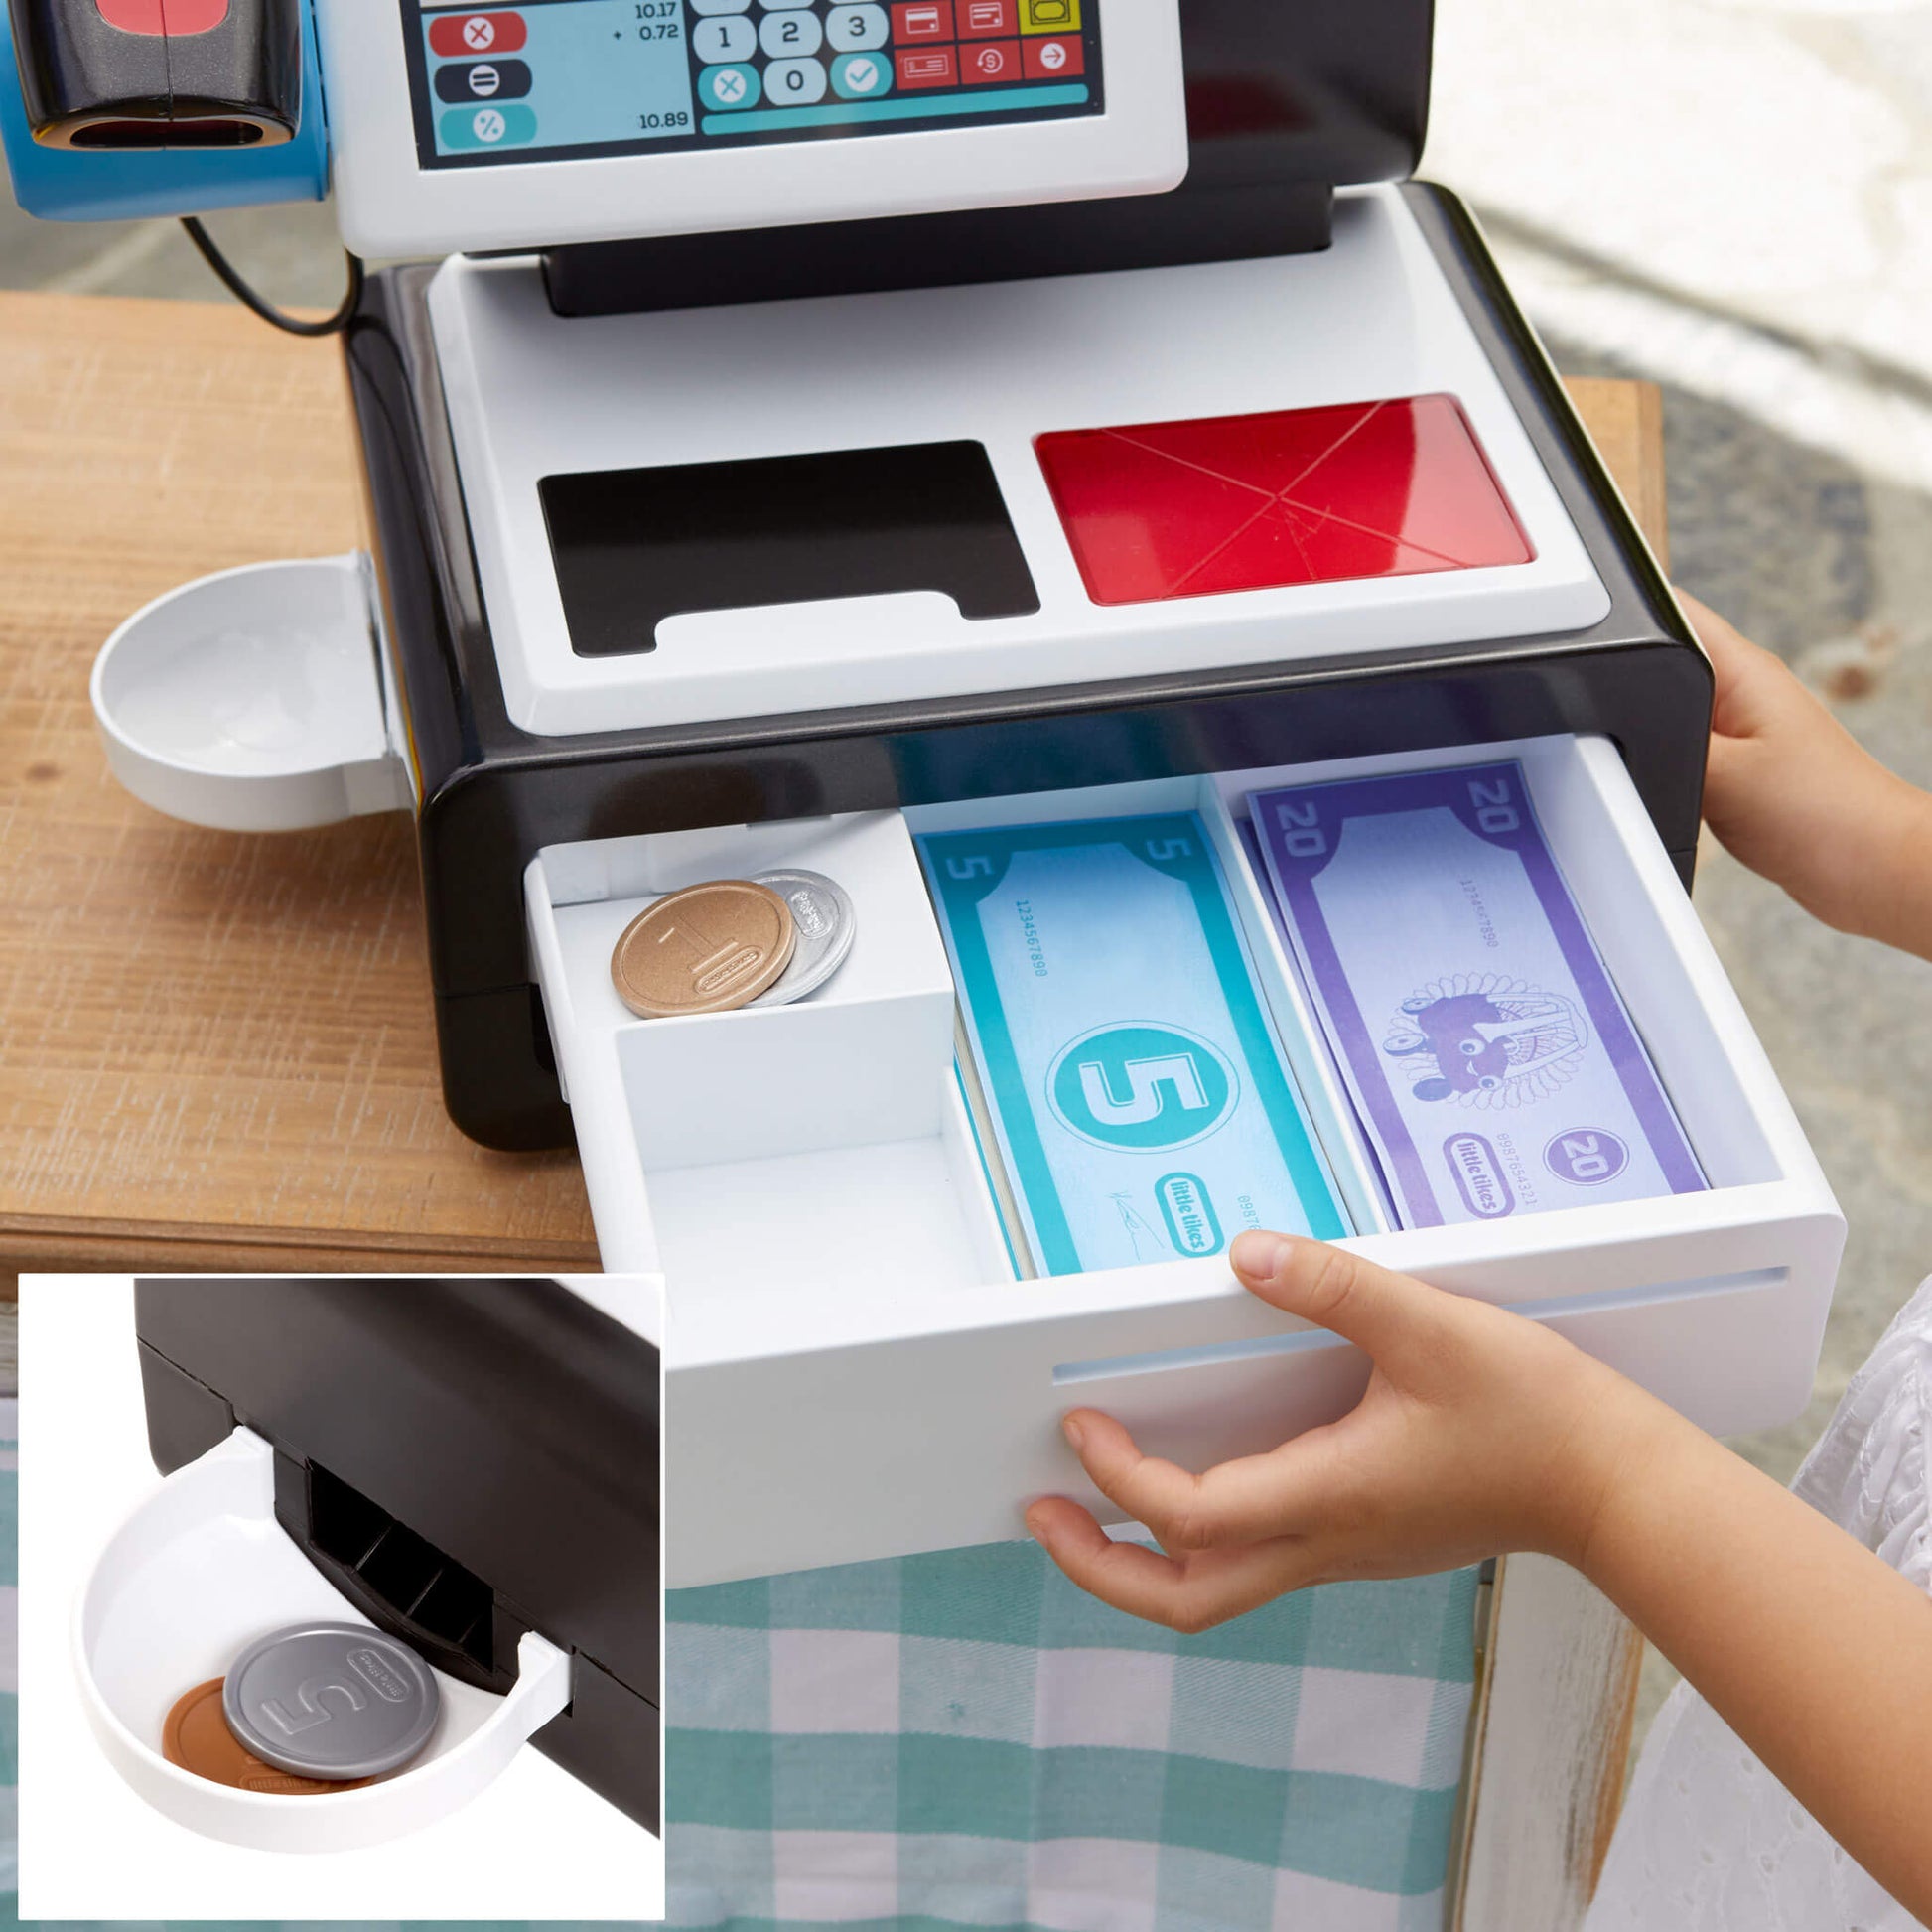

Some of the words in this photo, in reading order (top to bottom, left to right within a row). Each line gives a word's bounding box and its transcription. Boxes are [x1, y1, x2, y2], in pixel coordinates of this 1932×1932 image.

[635, 2, 677, 19] 10.17
[639, 24, 679, 40] 0.72
[718, 27, 732, 48] 1
[782, 22, 799, 43] 2
[848, 16, 866, 36] 3
[786, 70, 804, 91] 0
[639, 112, 689, 129] 10.89
[1467, 779, 1520, 833] 20
[1276, 801, 1327, 857] 20
[1147, 838, 1191, 860] 5
[946, 856, 993, 880] 5
[1016, 898, 1048, 977] 1234567890
[1078, 1052, 1209, 1125] 5
[1561, 1135, 1609, 1178] 20
[1456, 1142, 1484, 1173] little
[1471, 1174, 1497, 1210] tikes
[1170, 1181, 1194, 1213] little
[1182, 1214, 1205, 1249] tikes
[261, 1676, 368, 1735] 5
